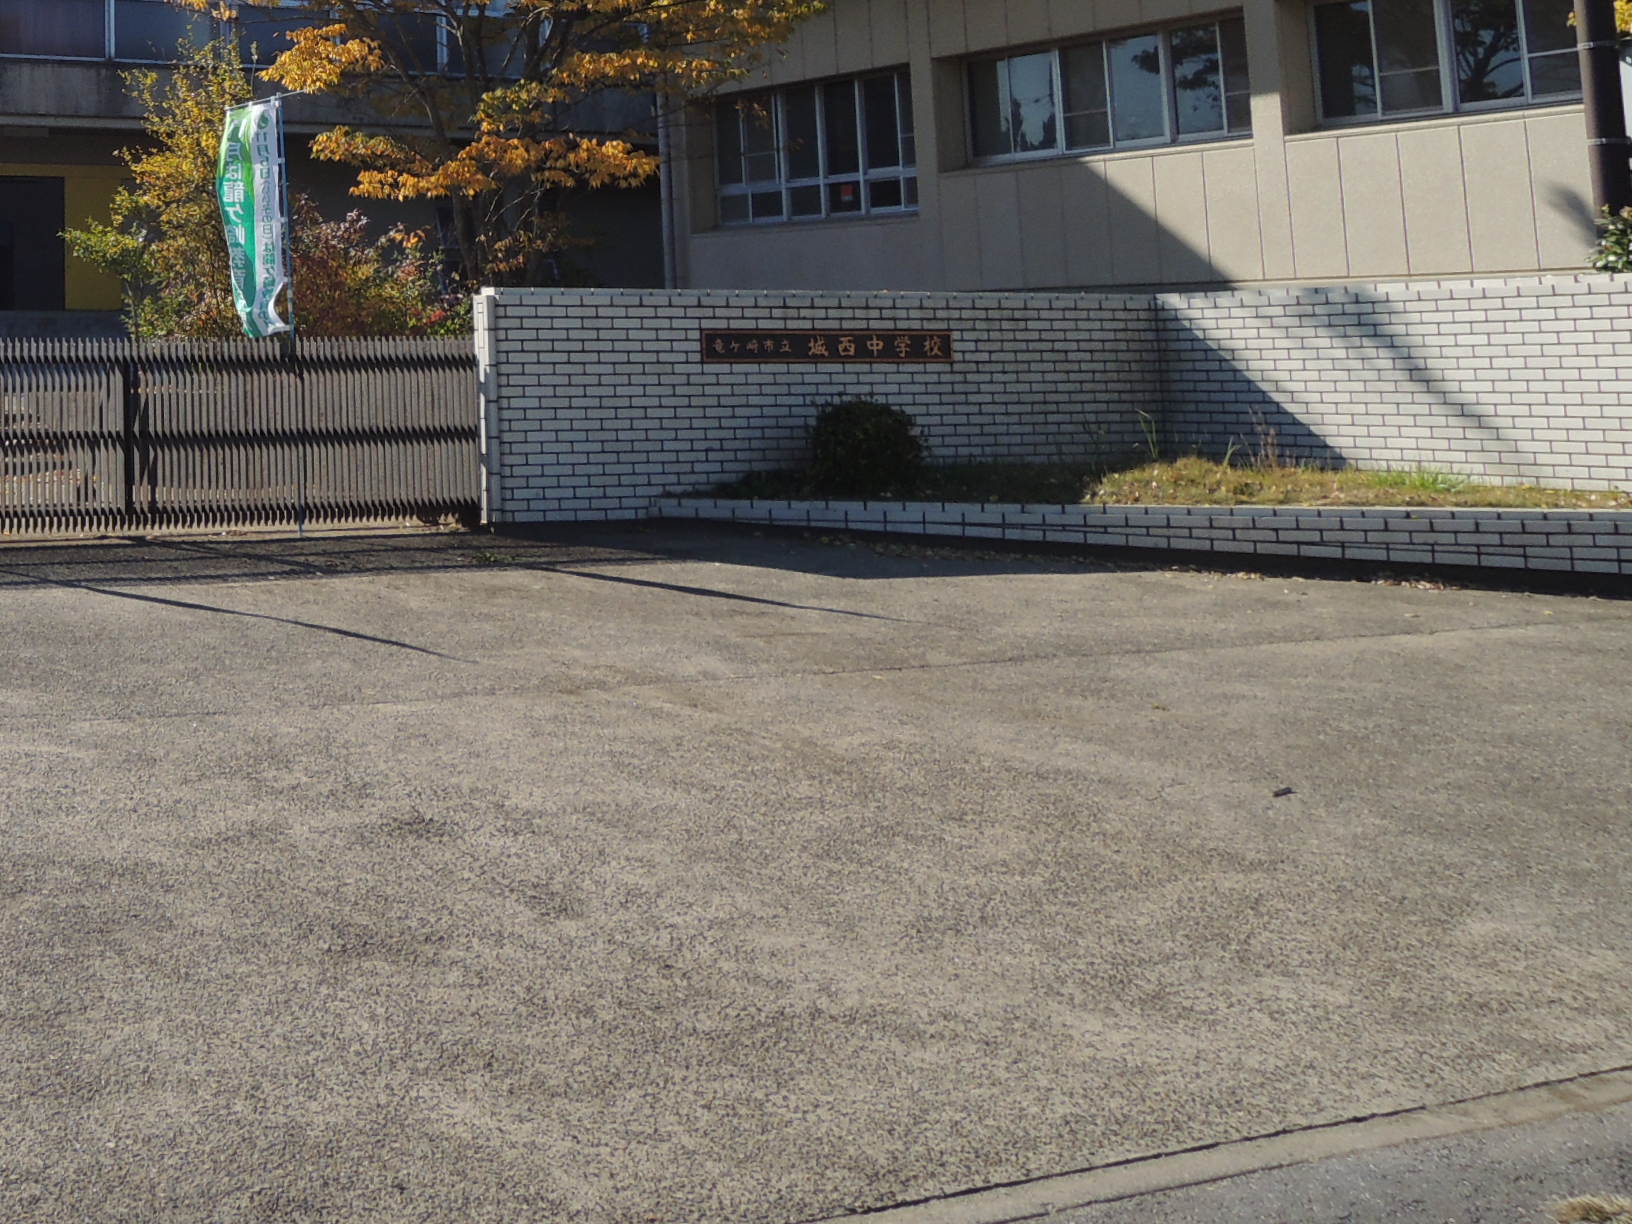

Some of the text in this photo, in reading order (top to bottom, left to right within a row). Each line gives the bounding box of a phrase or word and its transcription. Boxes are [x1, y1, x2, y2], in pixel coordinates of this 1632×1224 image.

[807, 335, 944, 358] 城西中学校
